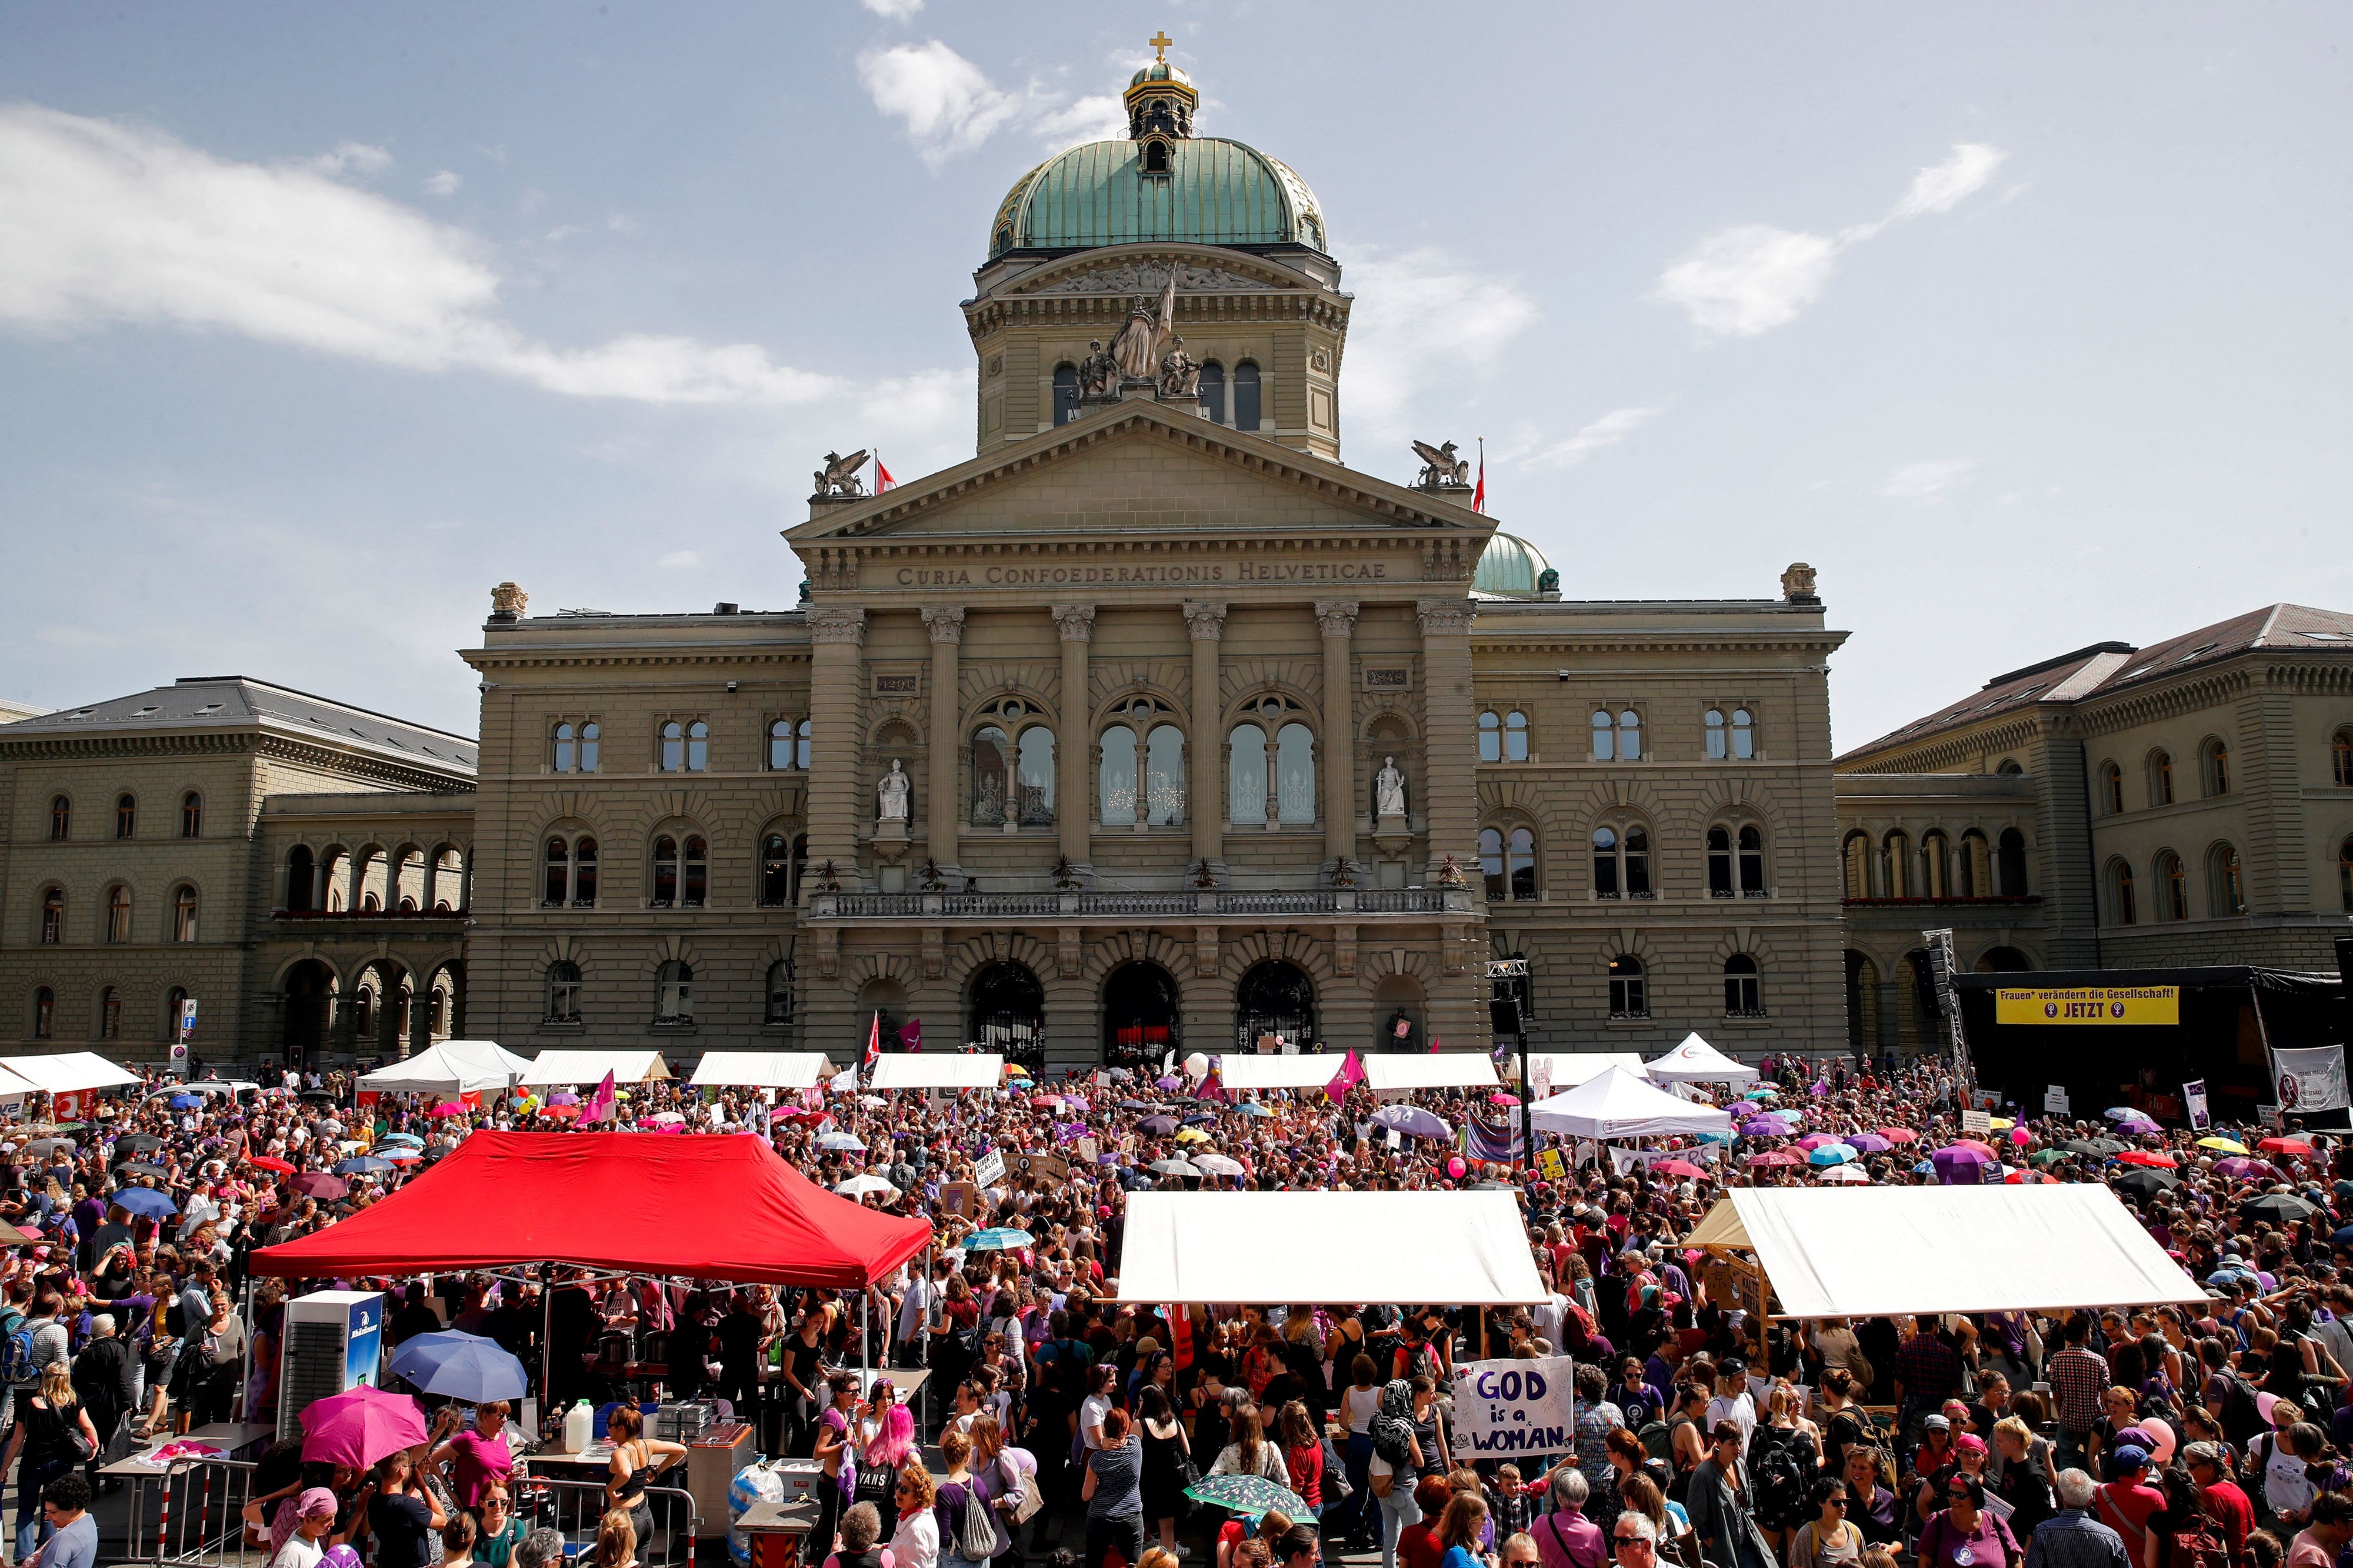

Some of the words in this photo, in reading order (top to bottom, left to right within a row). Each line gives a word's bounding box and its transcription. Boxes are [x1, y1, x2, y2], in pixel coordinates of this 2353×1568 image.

[896, 569, 971, 585] CURIA
[986, 566, 1222, 583] CONFOEDERATIONIS
[1238, 562, 1385, 579] HELVETICAE
[2038, 989, 2086, 999] verändern
[2089, 989, 2104, 999] die
[2107, 988, 2174, 999] Gesellschaft!
[2064, 1003, 2104, 1017] JETZT
[1742, 1276, 1759, 1299] KALTE
[351, 1325, 378, 1339] Rhäzünser
[1477, 1371, 1547, 1402] GOD
[1490, 1404, 1506, 1423] is
[1512, 1409, 1526, 1422] a
[1472, 1426, 1564, 1451] WOMAN
[859, 1472, 886, 1486] VANS
